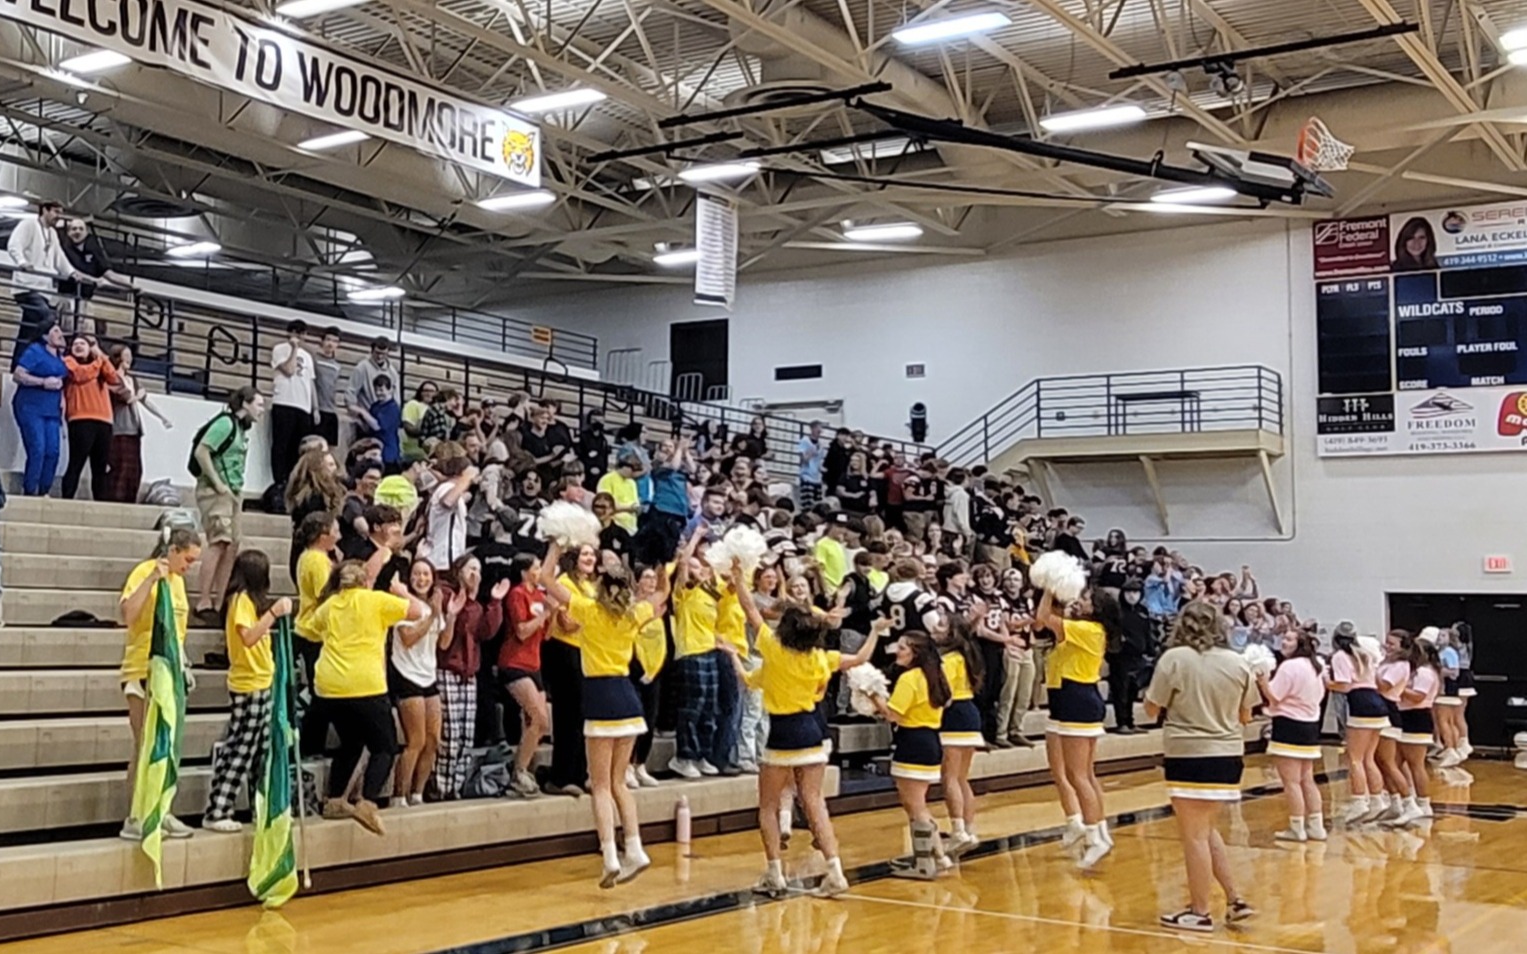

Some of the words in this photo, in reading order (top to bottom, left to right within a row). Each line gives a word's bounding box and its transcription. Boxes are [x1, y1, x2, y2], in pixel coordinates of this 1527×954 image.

[232, 24, 283, 92] TO
[297, 45, 496, 164] WOODMORE
[1339, 217, 1387, 231] Fremont
[1339, 229, 1379, 242] Federal
[1455, 233, 1488, 245] LANA
[1398, 301, 1465, 317] WILDCATS
[1469, 305, 1504, 316] PERIOD
[1398, 346, 1428, 357] FOULS
[1456, 342, 1492, 354] PLAYER
[1493, 340, 1518, 352] FOUL
[1398, 379, 1428, 390] SCORE
[1471, 376, 1505, 386] MATCH
[1407, 418, 1476, 430] FREEDOM
